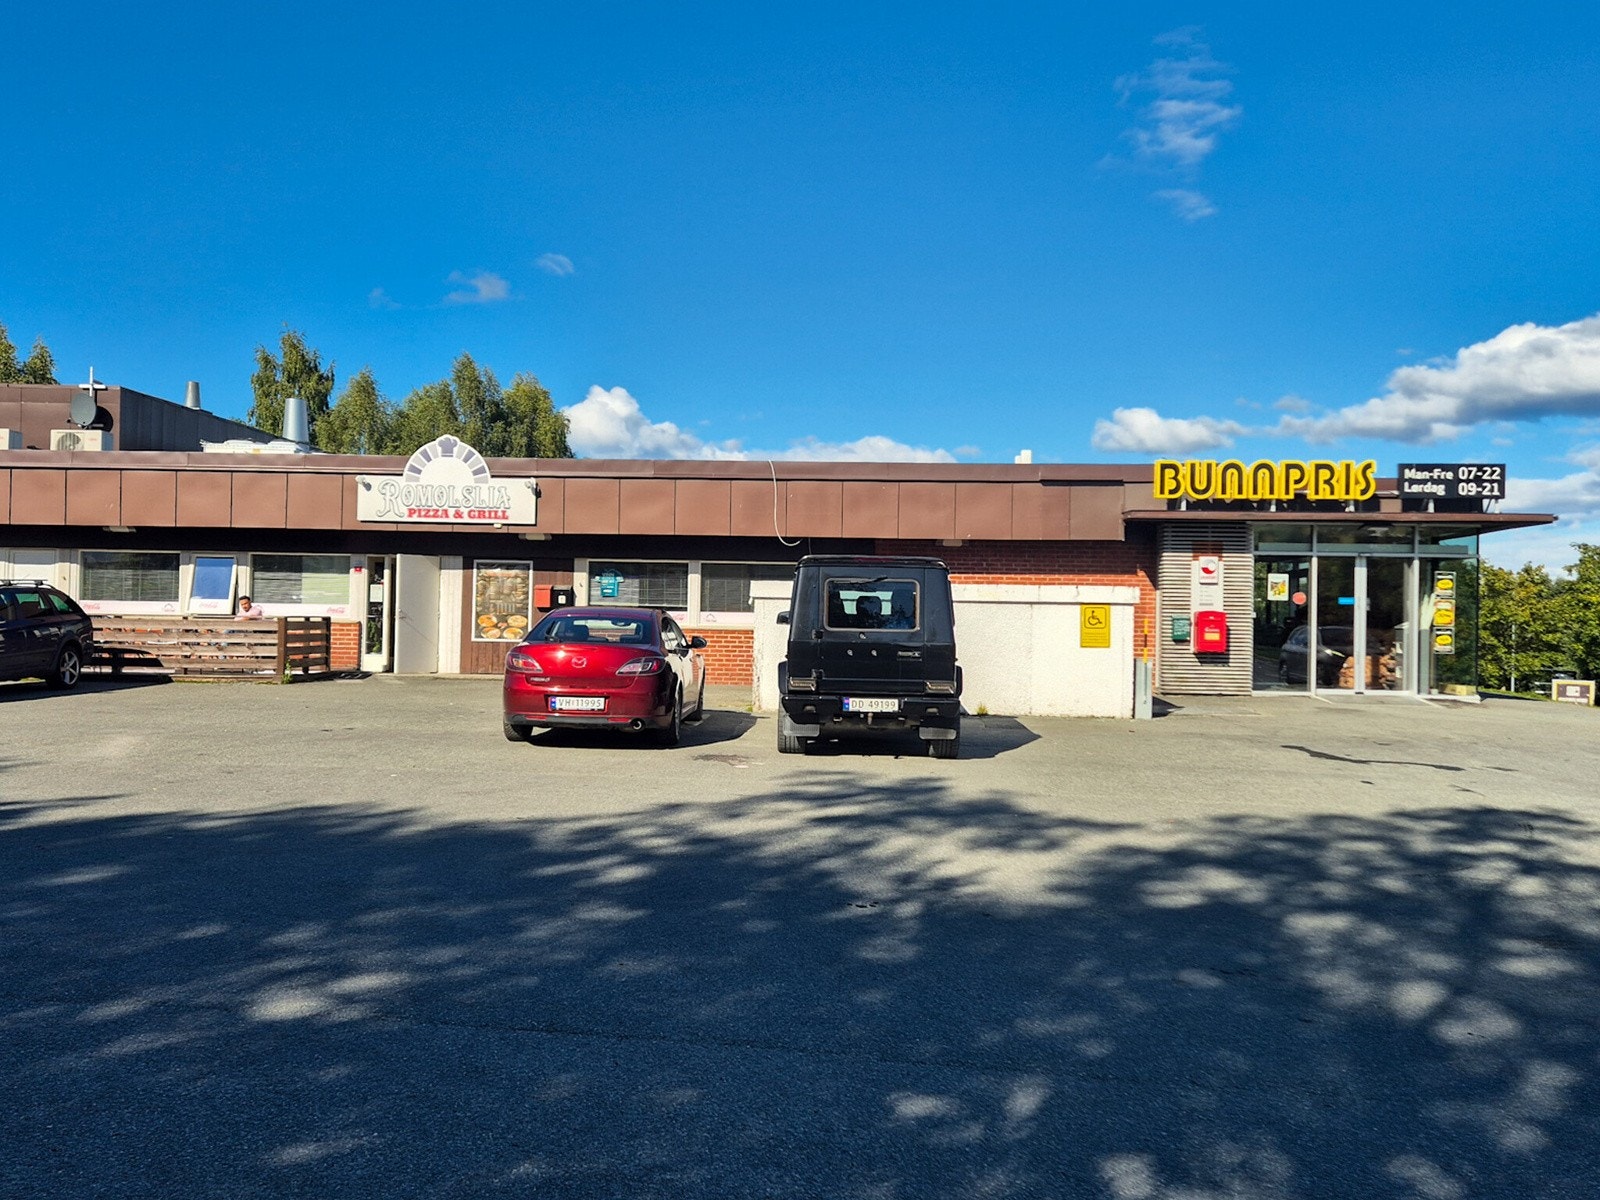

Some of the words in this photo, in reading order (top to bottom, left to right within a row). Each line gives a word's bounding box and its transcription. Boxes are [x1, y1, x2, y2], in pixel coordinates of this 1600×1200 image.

[1154, 459, 1377, 500] BUNNPRIS
[1403, 468, 1454, 480] Man-Fre
[1458, 466, 1501, 480] 07-22
[1403, 481, 1446, 496] Lørdag
[1458, 482, 1500, 496] 09-21
[376, 479, 511, 518] ROMOLSLIA
[407, 508, 450, 519] PIZZA
[453, 509, 464, 519] &
[467, 510, 509, 520] GRILL
[558, 698, 571, 707] VH
[576, 699, 601, 707] 11995
[851, 700, 864, 709] DD
[868, 700, 896, 709] 49199
